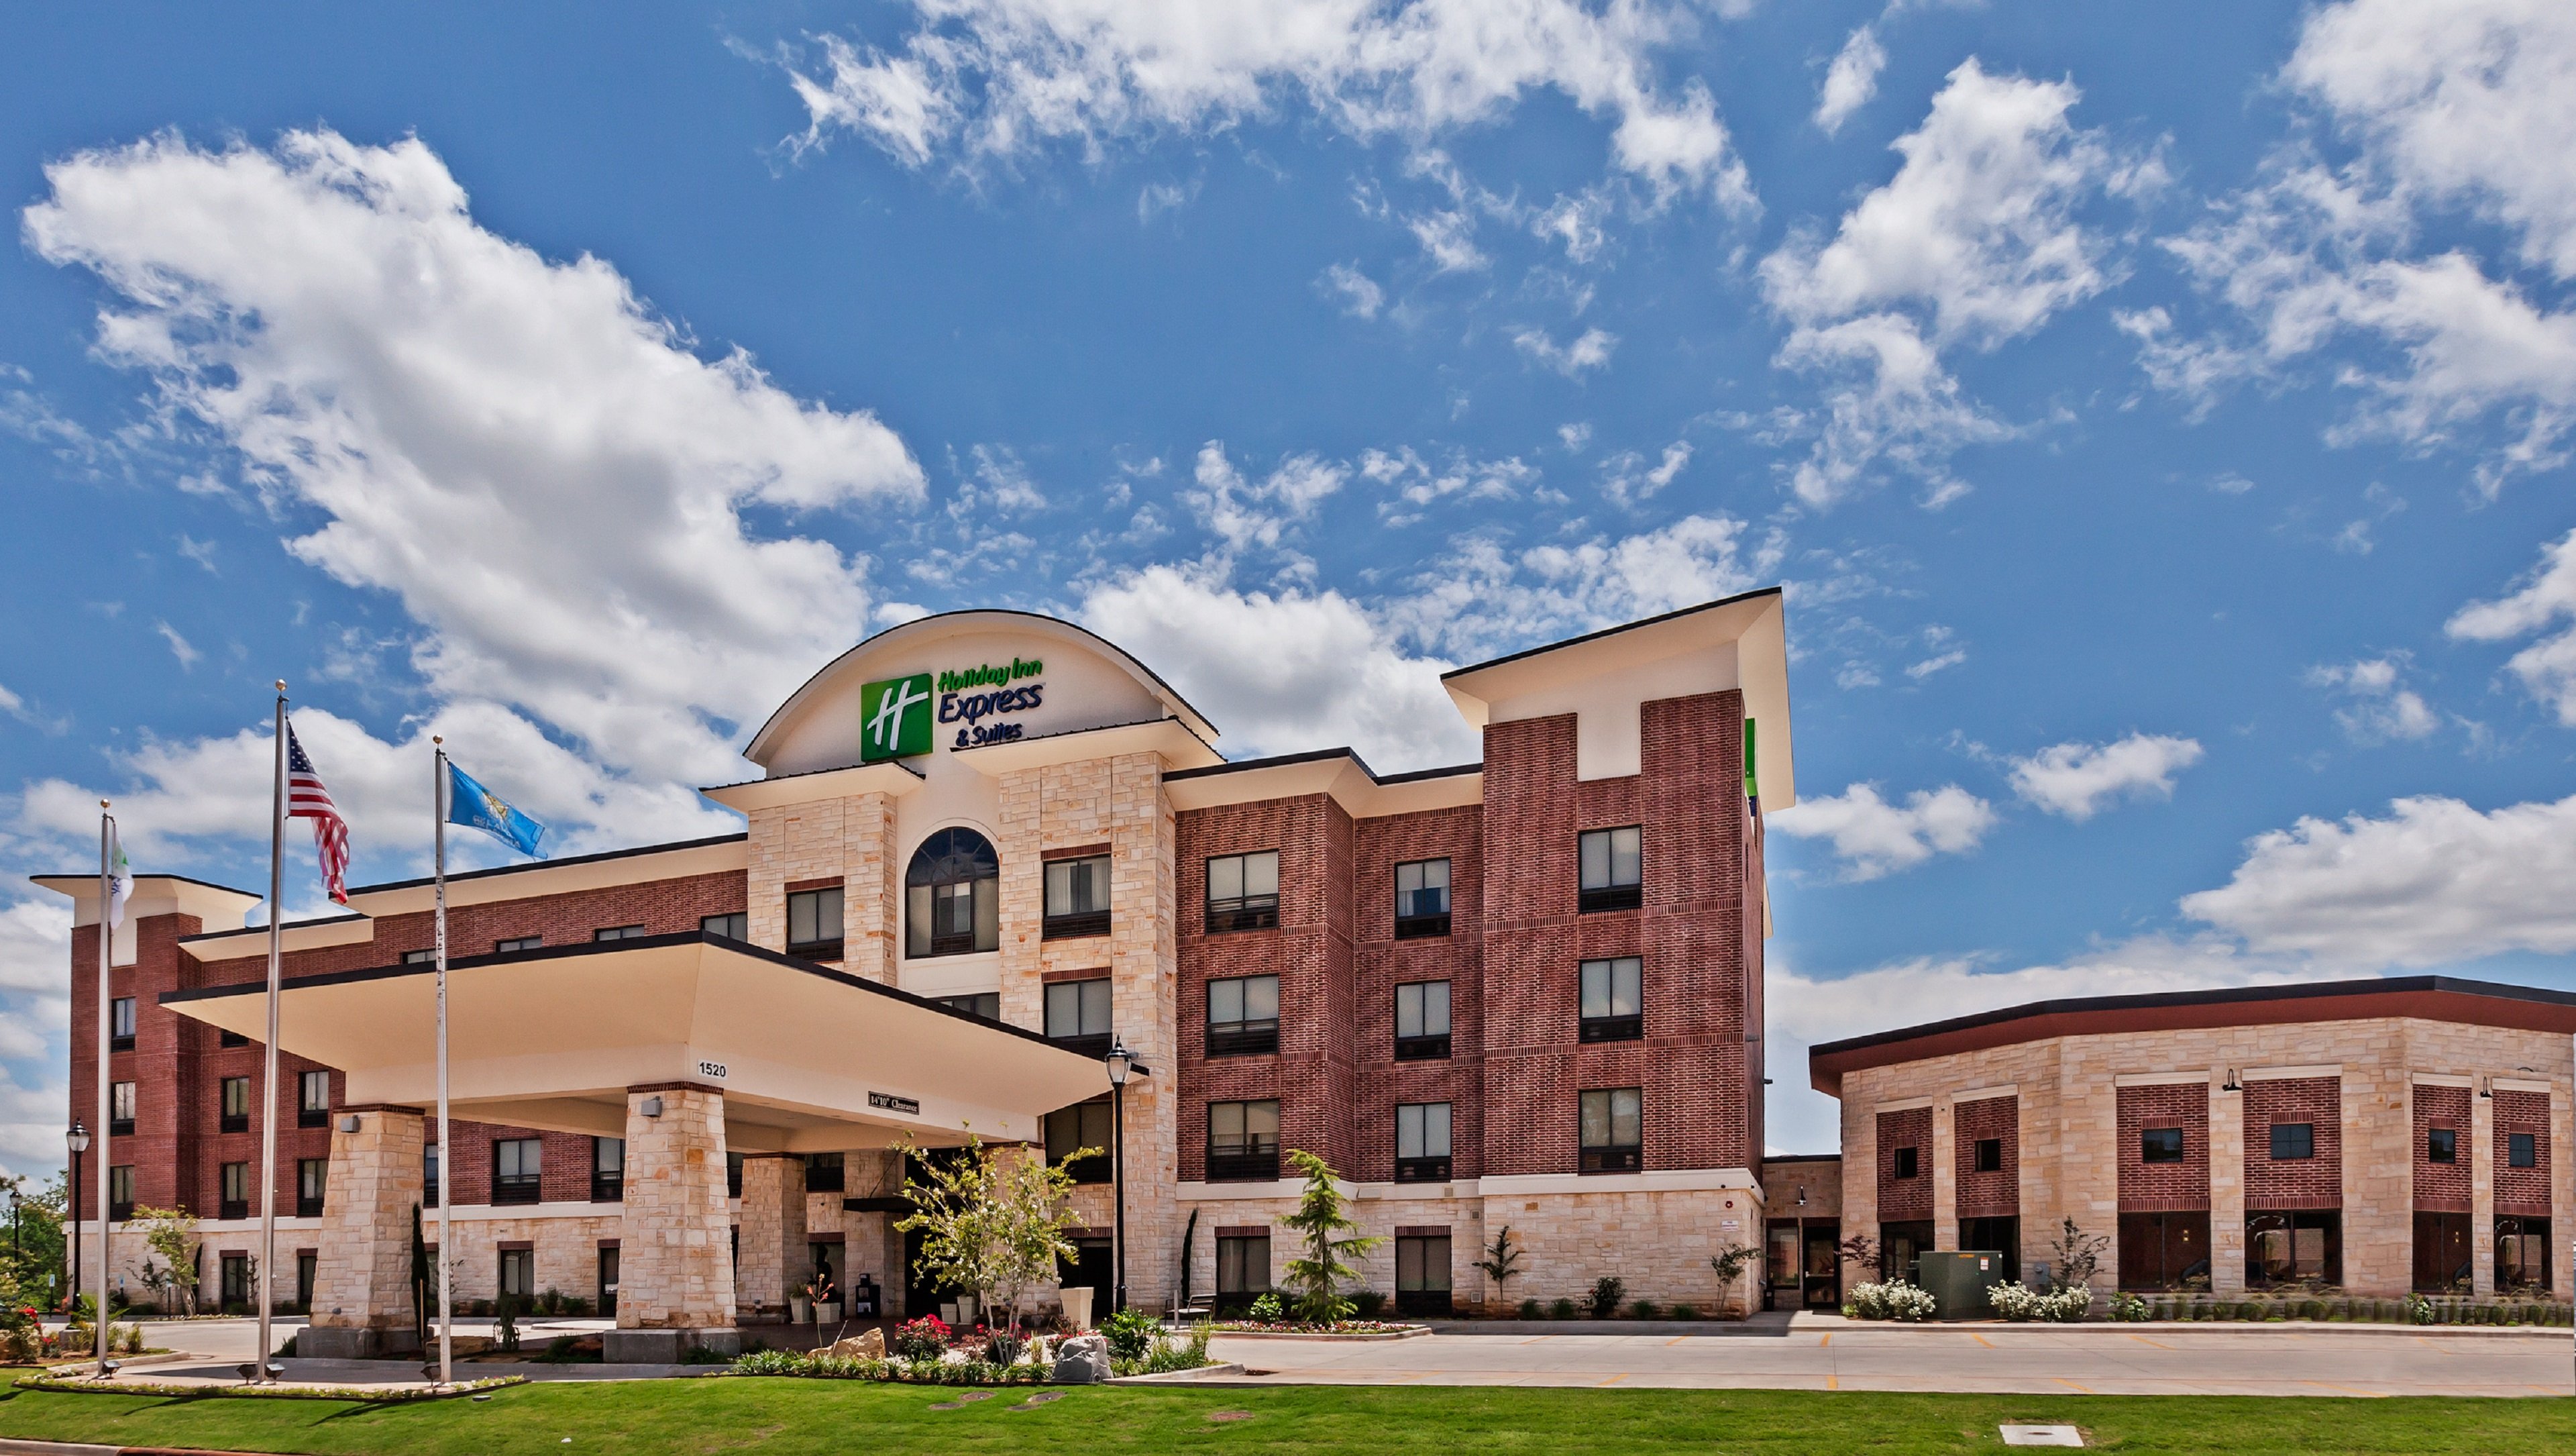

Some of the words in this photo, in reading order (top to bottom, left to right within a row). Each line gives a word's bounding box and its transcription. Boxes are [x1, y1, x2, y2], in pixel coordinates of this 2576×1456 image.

[937, 664, 1011, 693] Holiday
[1012, 658, 1042, 679] Inn
[867, 680, 928, 751] H
[938, 684, 1043, 726] Express
[956, 729, 969, 747] &
[971, 722, 1022, 745] Suites
[699, 1061, 727, 1078] 1520
[892, 1099, 918, 1112] Clearance
